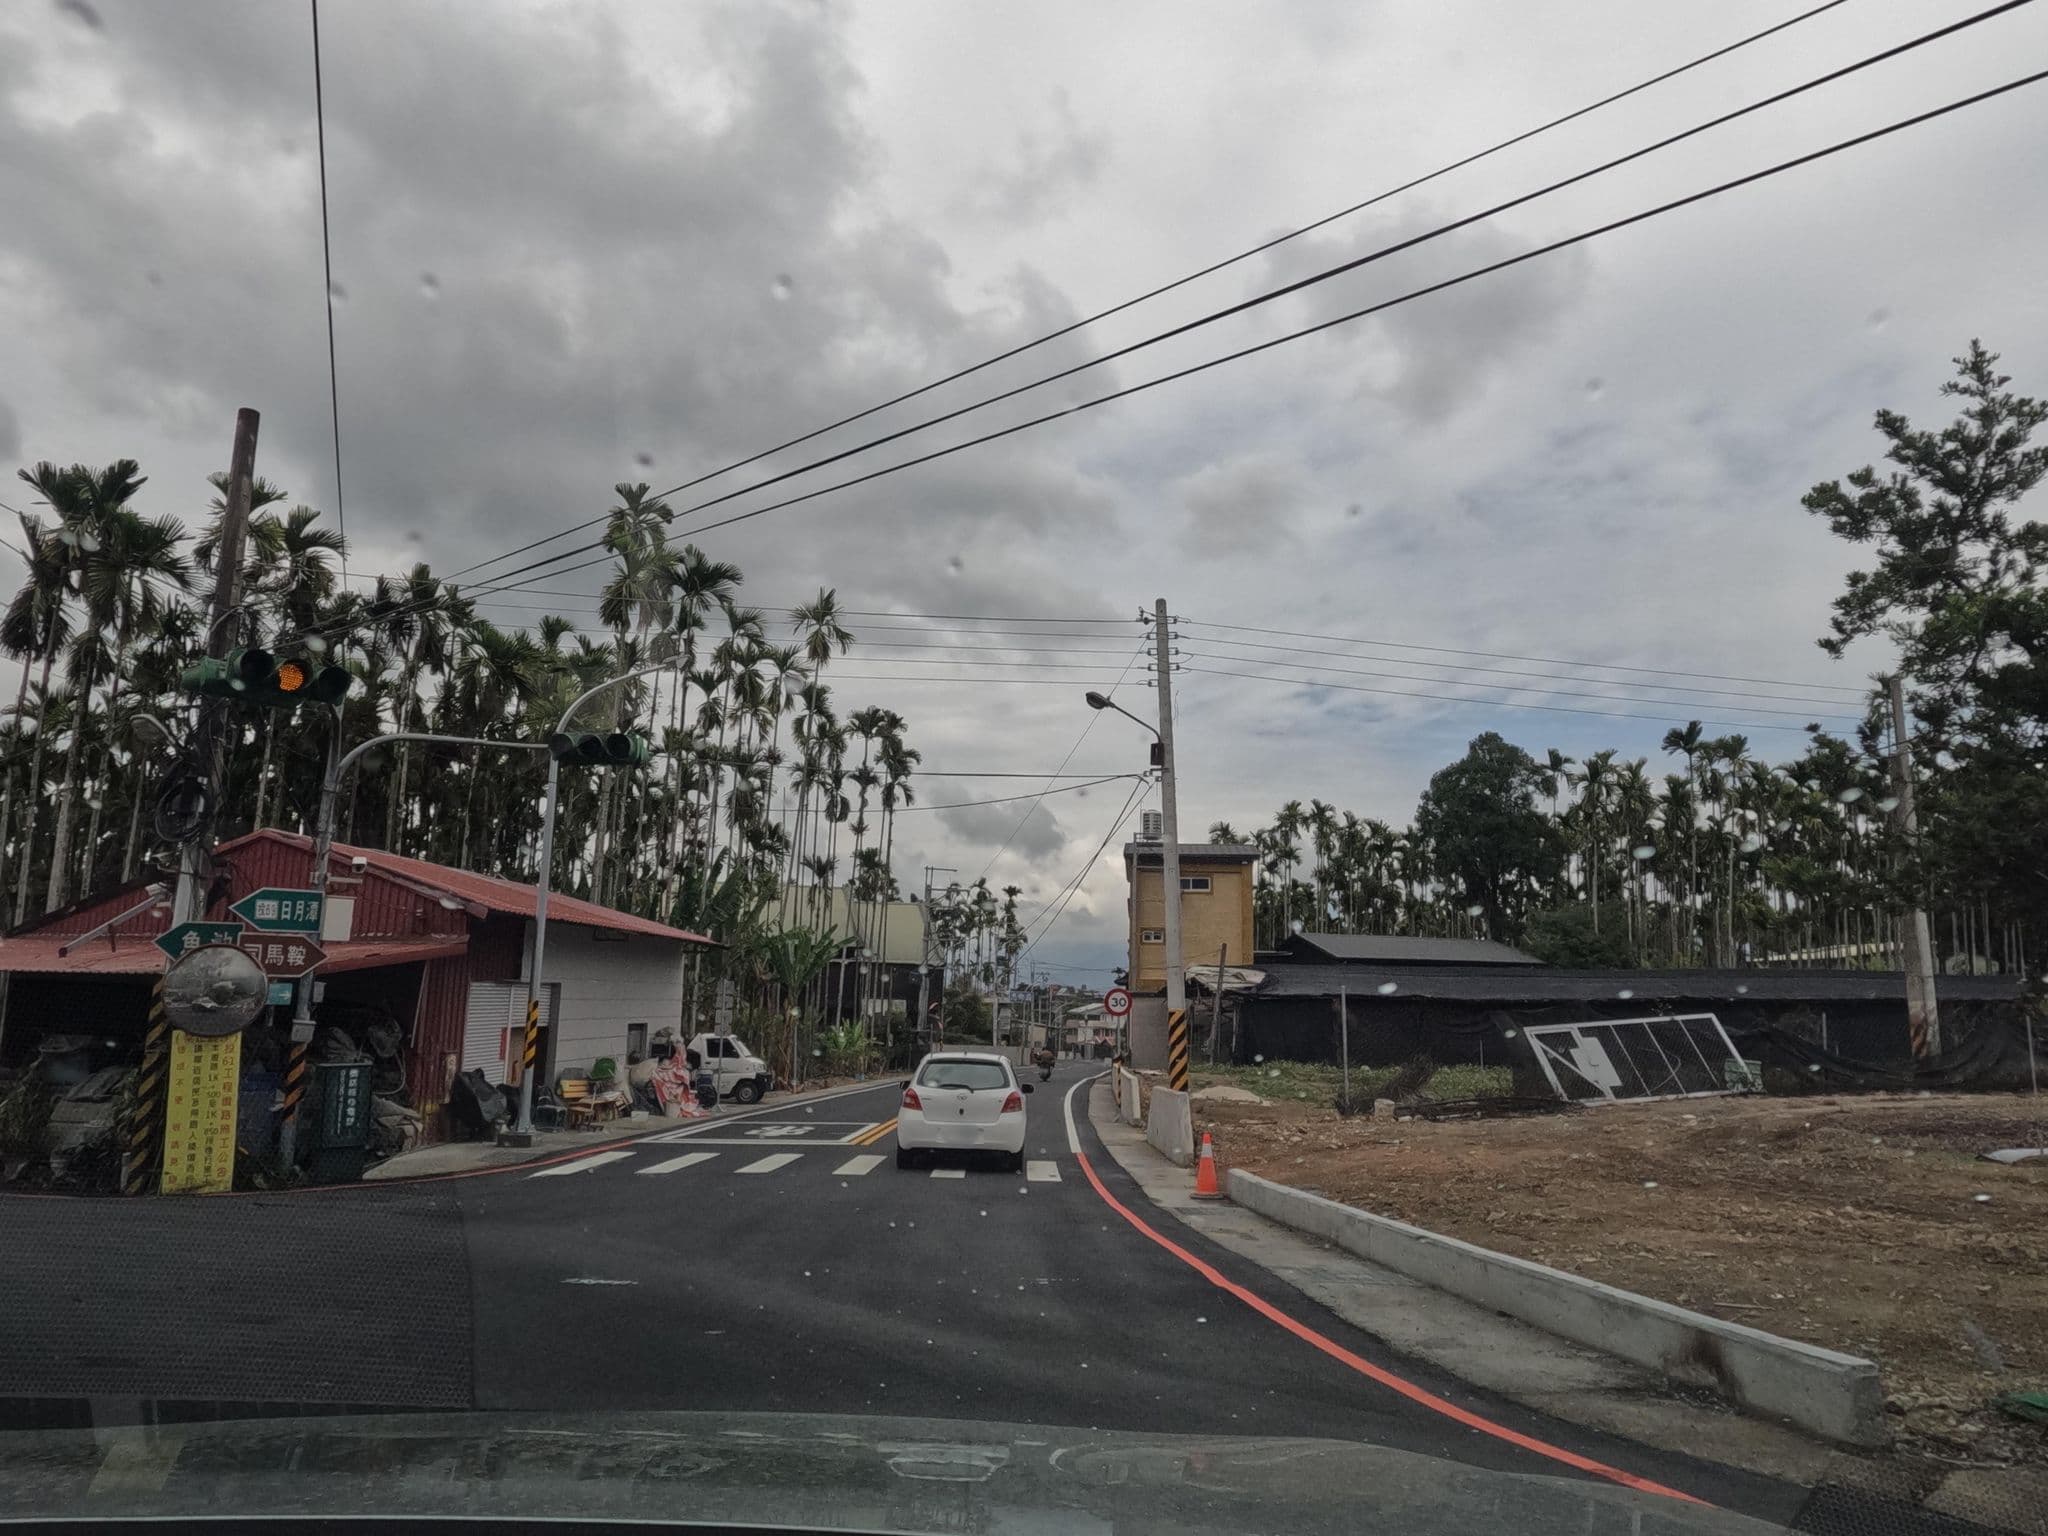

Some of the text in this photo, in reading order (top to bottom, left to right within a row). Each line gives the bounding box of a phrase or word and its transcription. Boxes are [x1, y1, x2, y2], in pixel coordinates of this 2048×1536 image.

[281, 900, 319, 922] 日月潭
[244, 943, 306, 966] 司馬鞍
[1111, 997, 1127, 1007] 30
